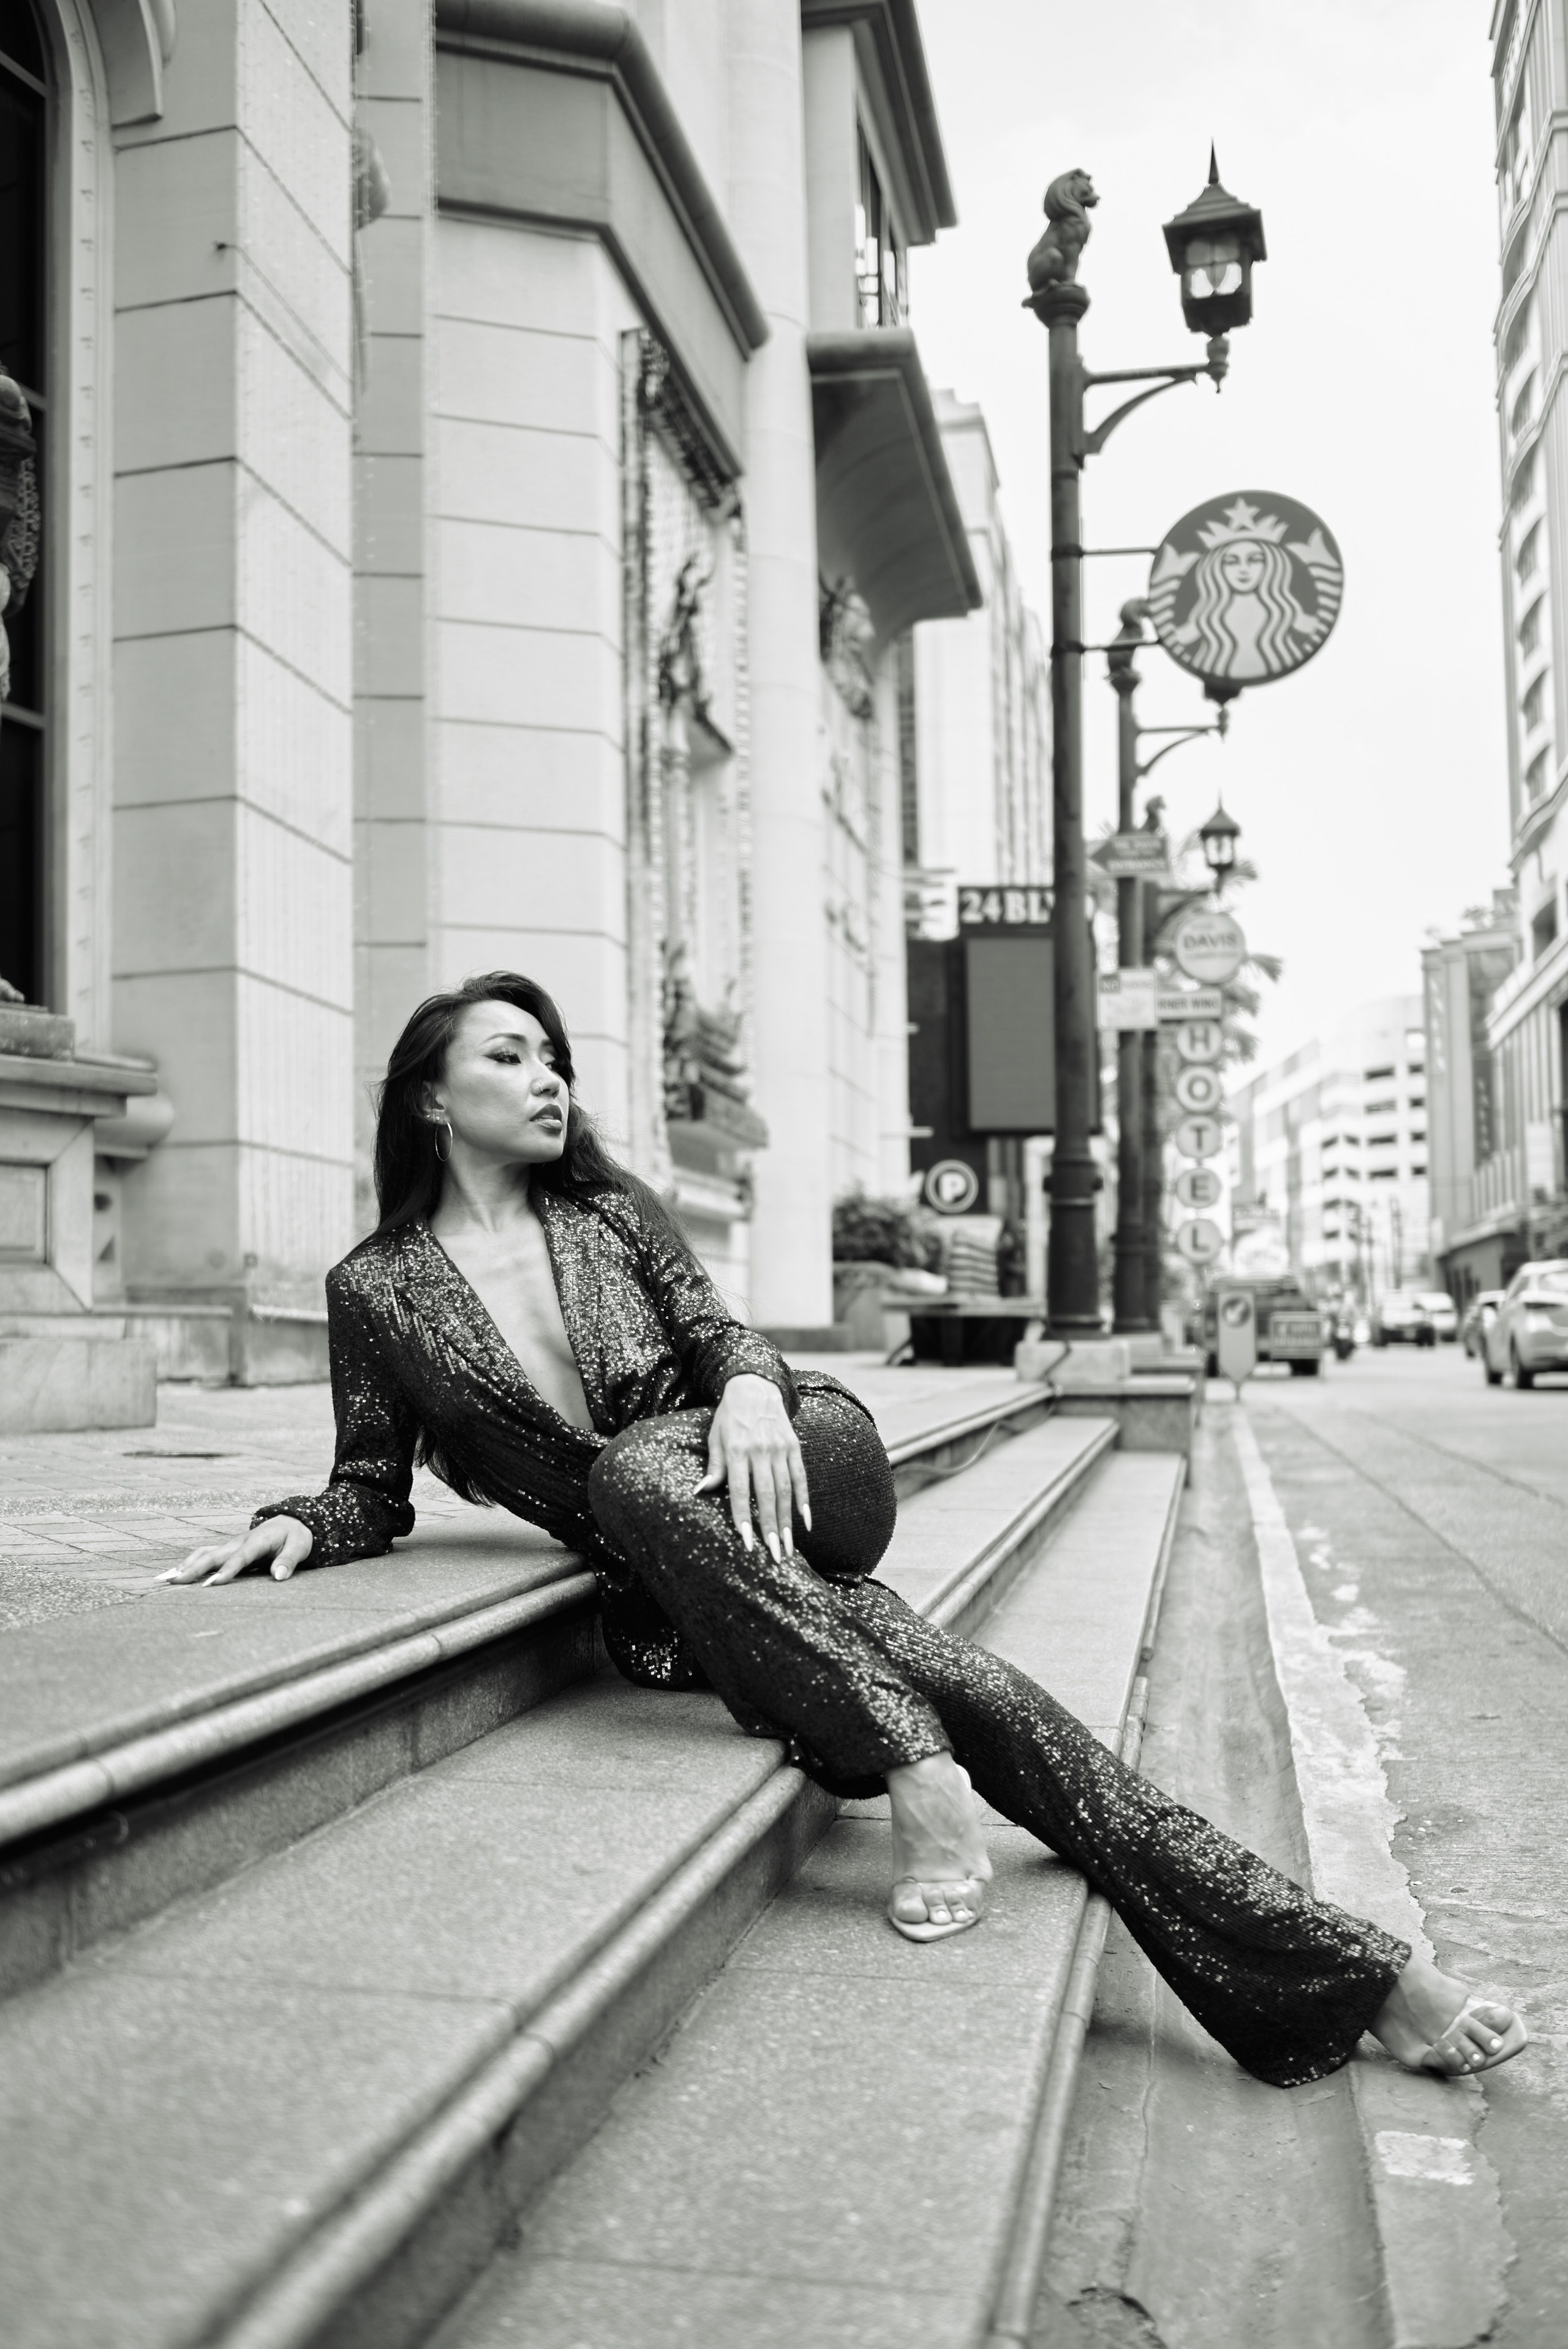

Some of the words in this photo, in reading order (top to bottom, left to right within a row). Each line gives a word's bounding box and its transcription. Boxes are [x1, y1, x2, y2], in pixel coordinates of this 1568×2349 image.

[1108, 859, 1166, 870] ENTRANCE
[1183, 932, 1238, 949] DAVIS
[1102, 979, 1119, 991] NO
[1121, 979, 1154, 990] PARKING
[1157, 998, 1188, 1010] RNER
[1191, 997, 1219, 1009] WING
[1187, 1024, 1213, 1252] HOTEL
[939, 1172, 967, 1201] P
